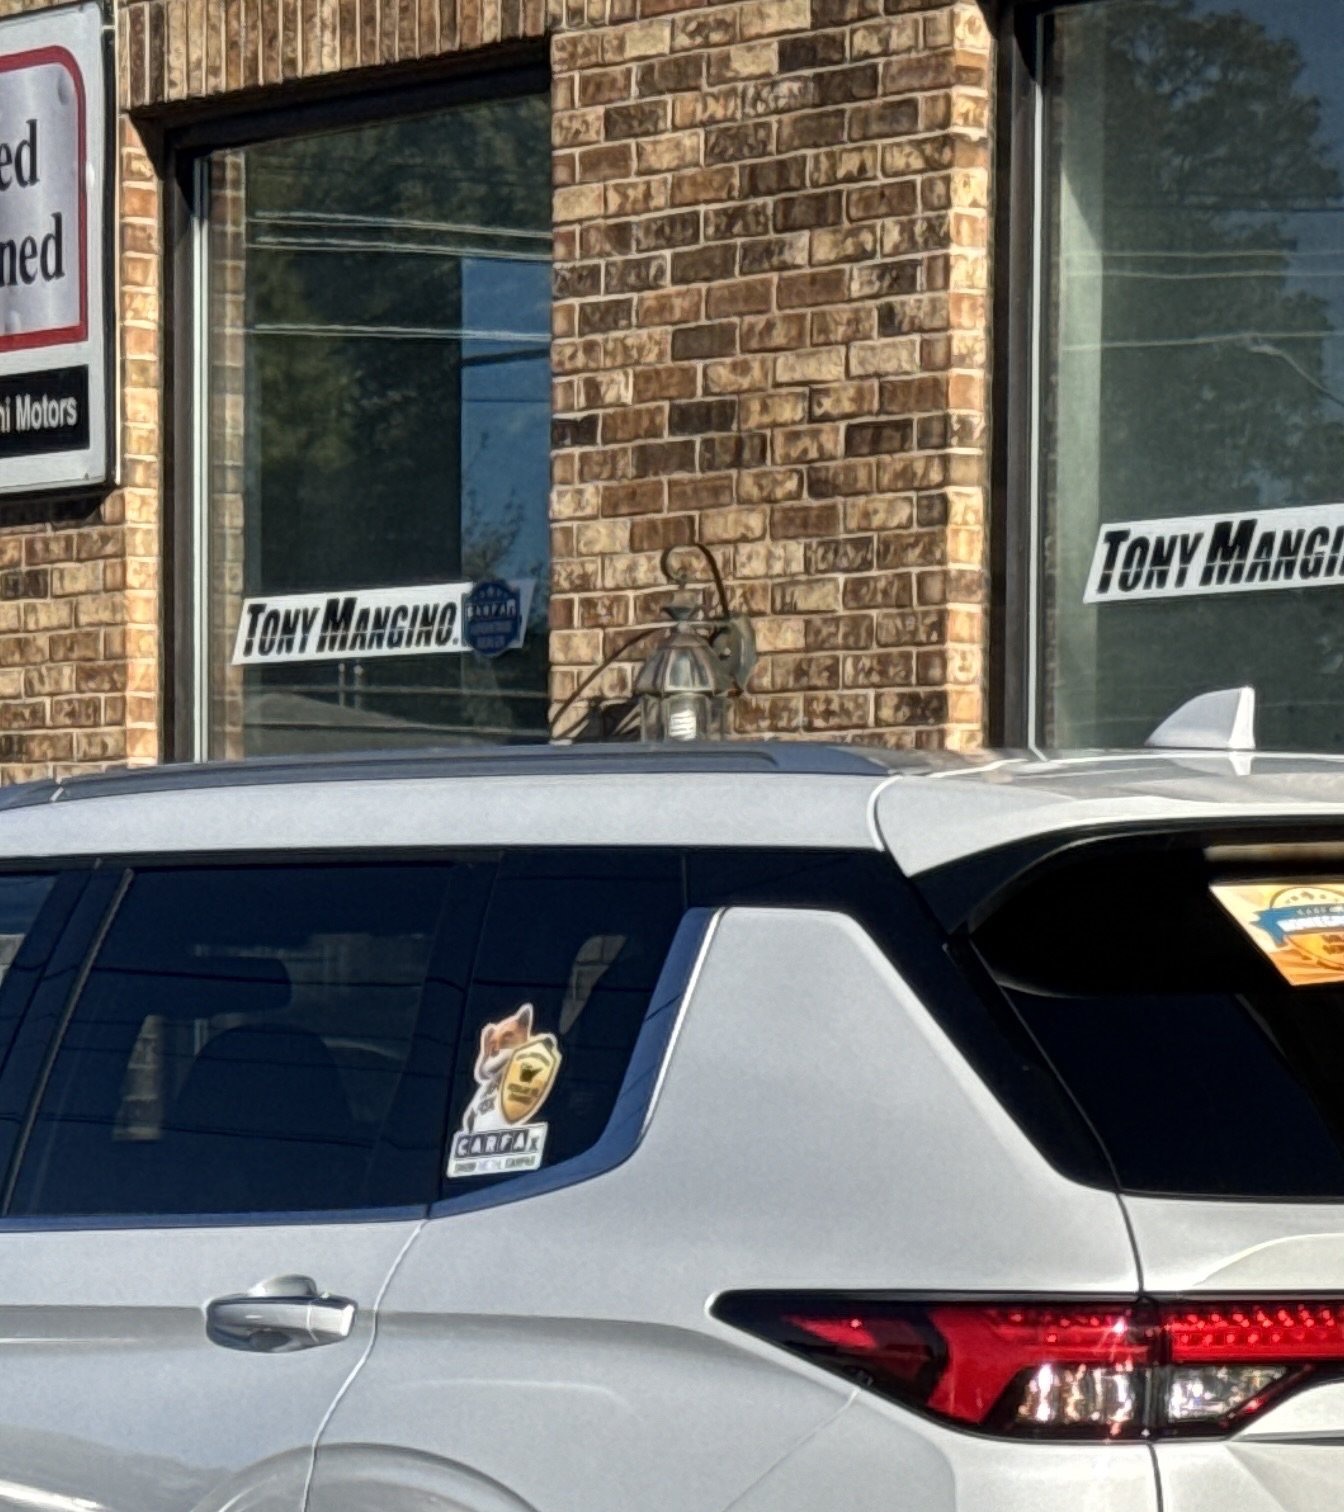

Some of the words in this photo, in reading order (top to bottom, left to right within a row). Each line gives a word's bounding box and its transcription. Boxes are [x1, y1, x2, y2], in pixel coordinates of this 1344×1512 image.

[15, 395, 78, 432] Motors
[1095, 528, 1204, 595] TONY
[242, 602, 320, 657] TONY
[456, 1131, 541, 1157] CARFAX
